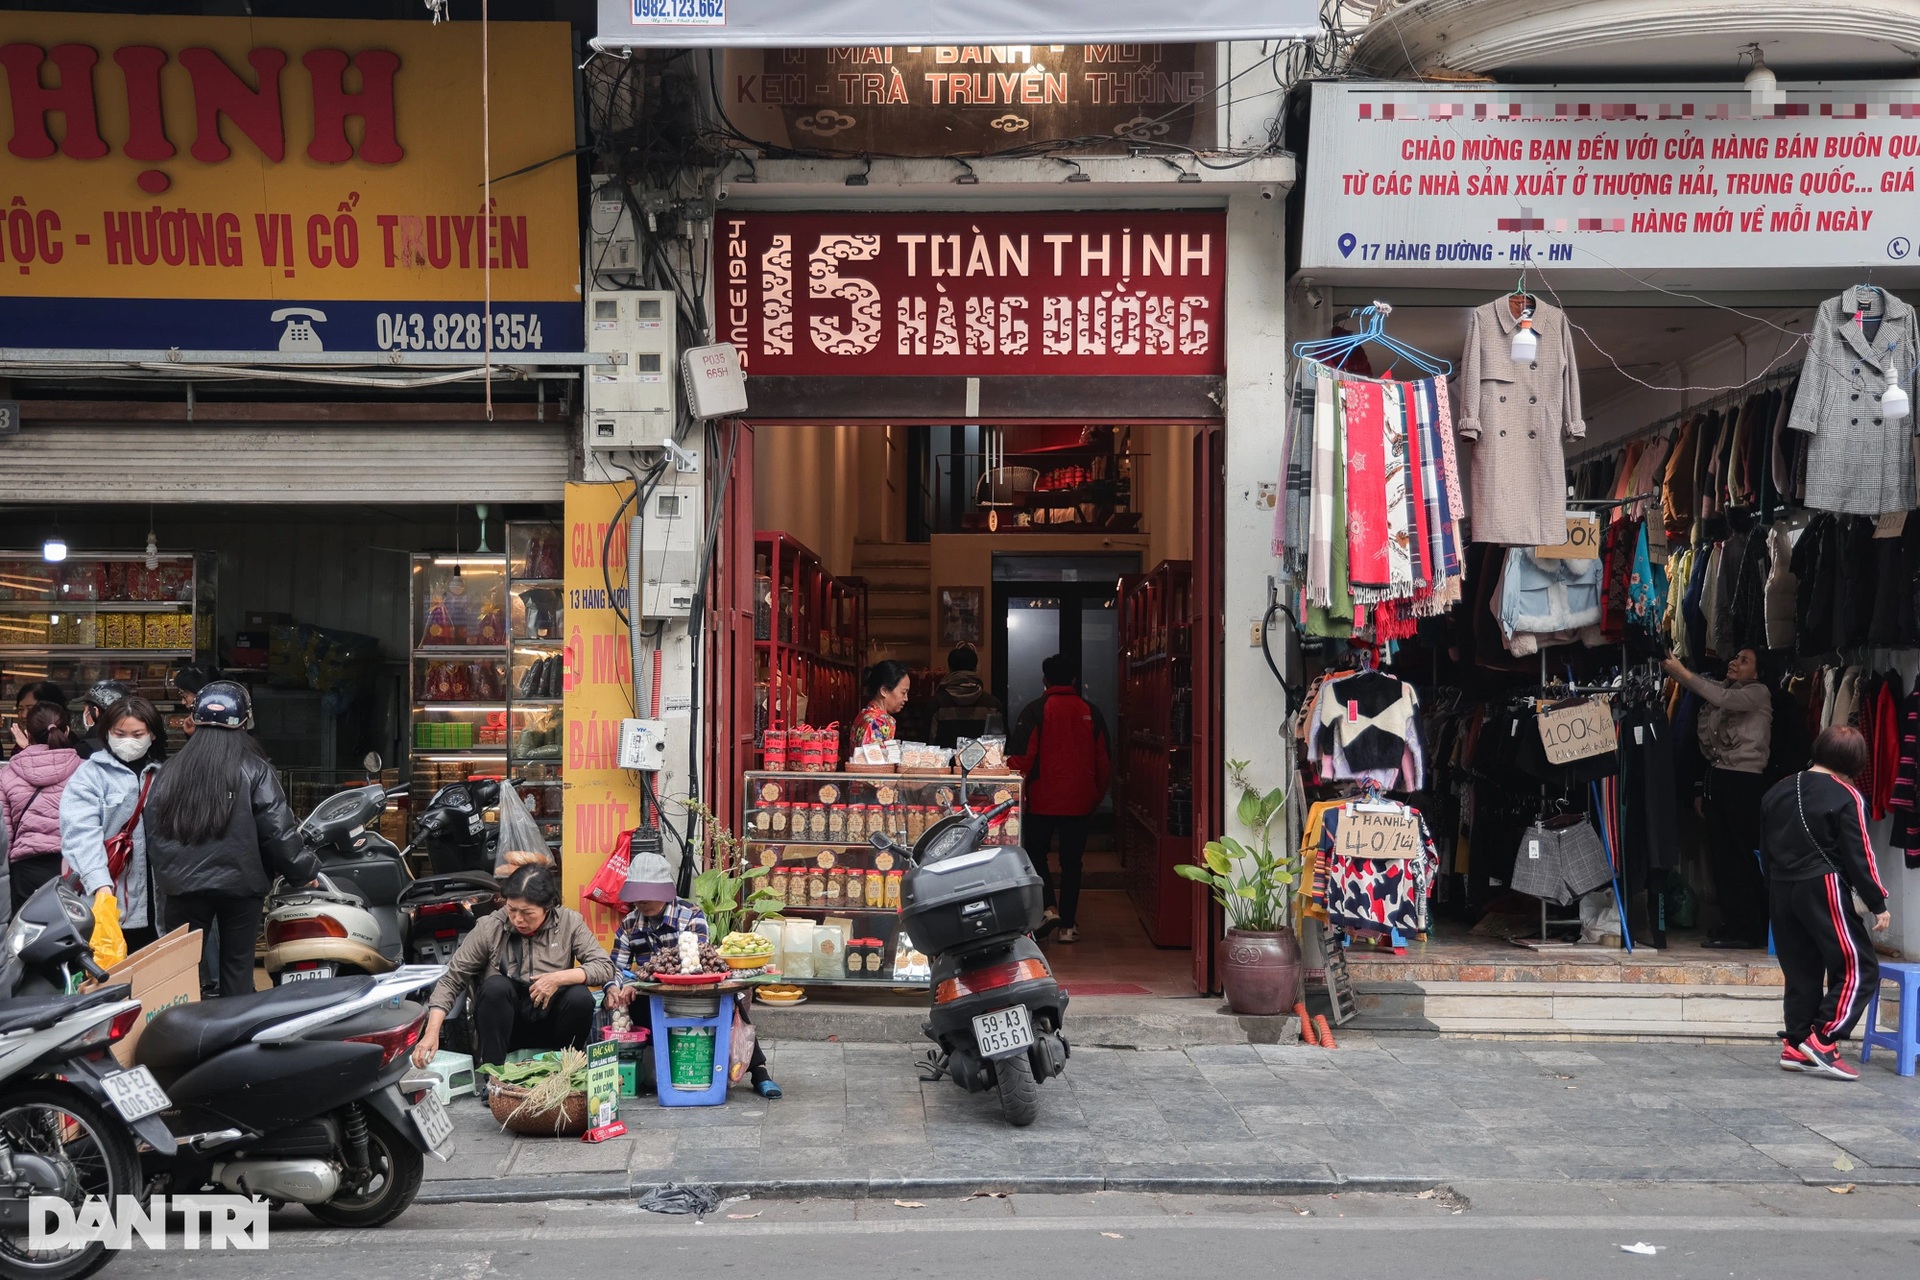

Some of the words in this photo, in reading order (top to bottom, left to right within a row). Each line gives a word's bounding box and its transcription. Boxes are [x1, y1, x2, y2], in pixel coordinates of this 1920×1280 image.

[838, 66, 909, 104] TRÀ
[925, 62, 1068, 105] TRUYỀN
[1085, 63, 1204, 104] THỐNG
[1401, 134, 1456, 161] CHÀO
[1462, 134, 1523, 161] MỪNG
[1529, 138, 1572, 165] BẠN
[1577, 131, 1620, 161] ĐẾN
[1626, 132, 1659, 160] VỚI
[1664, 129, 1705, 160] CỬA
[1711, 132, 1768, 160] HÀNG
[1774, 132, 1819, 159] BÁN
[1824, 131, 1883, 158] BUÔN
[1342, 168, 1370, 196] TỪ
[1372, 169, 1413, 196] CÁC
[1418, 169, 1461, 196] NHÀ
[1466, 165, 1509, 196] SẢN
[1514, 166, 1567, 195] XUẤT
[1572, 165, 1589, 195] Ở
[1593, 171, 1672, 200] THƯỢNG
[1678, 165, 1718, 198] HẢI,
[1726, 172, 1794, 195] TRUNG
[1800, 164, 1873, 194] QUỐC...
[1880, 166, 1915, 193] GIÁ
[104, 205, 244, 268] HƯƠNG
[255, 213, 296, 278] VỊ
[307, 191, 360, 269] CỔ
[1631, 207, 1687, 233] HÀNG
[1693, 205, 1734, 233] MỚI
[1739, 204, 1767, 233] VỀ
[1770, 203, 1811, 232] MỖI
[1816, 205, 1873, 232] NGÀY
[897, 224, 1030, 277] TOÀN
[1043, 227, 1211, 284] THỊNH
[1361, 244, 1380, 261] 17
[1385, 239, 1431, 261] HÀNG
[1435, 239, 1493, 261] ĐƯỜNG
[1509, 244, 1533, 261] HK
[1550, 244, 1573, 261] HN
[762, 234, 882, 356] 15
[376, 313, 543, 351] 043.8281354
[897, 282, 1030, 356] HÀNG
[572, 522, 595, 568] GIA
[570, 589, 580, 609] 13
[582, 585, 606, 609] HÀNG
[569, 710, 618, 770] BÁN
[576, 791, 629, 854] MỨT
[982, 1026, 1028, 1052] 055.61
[110, 1069, 151, 1096] 29-E2
[120, 1087, 167, 1117] 006.69
[427, 1113, 451, 1144] 8144
